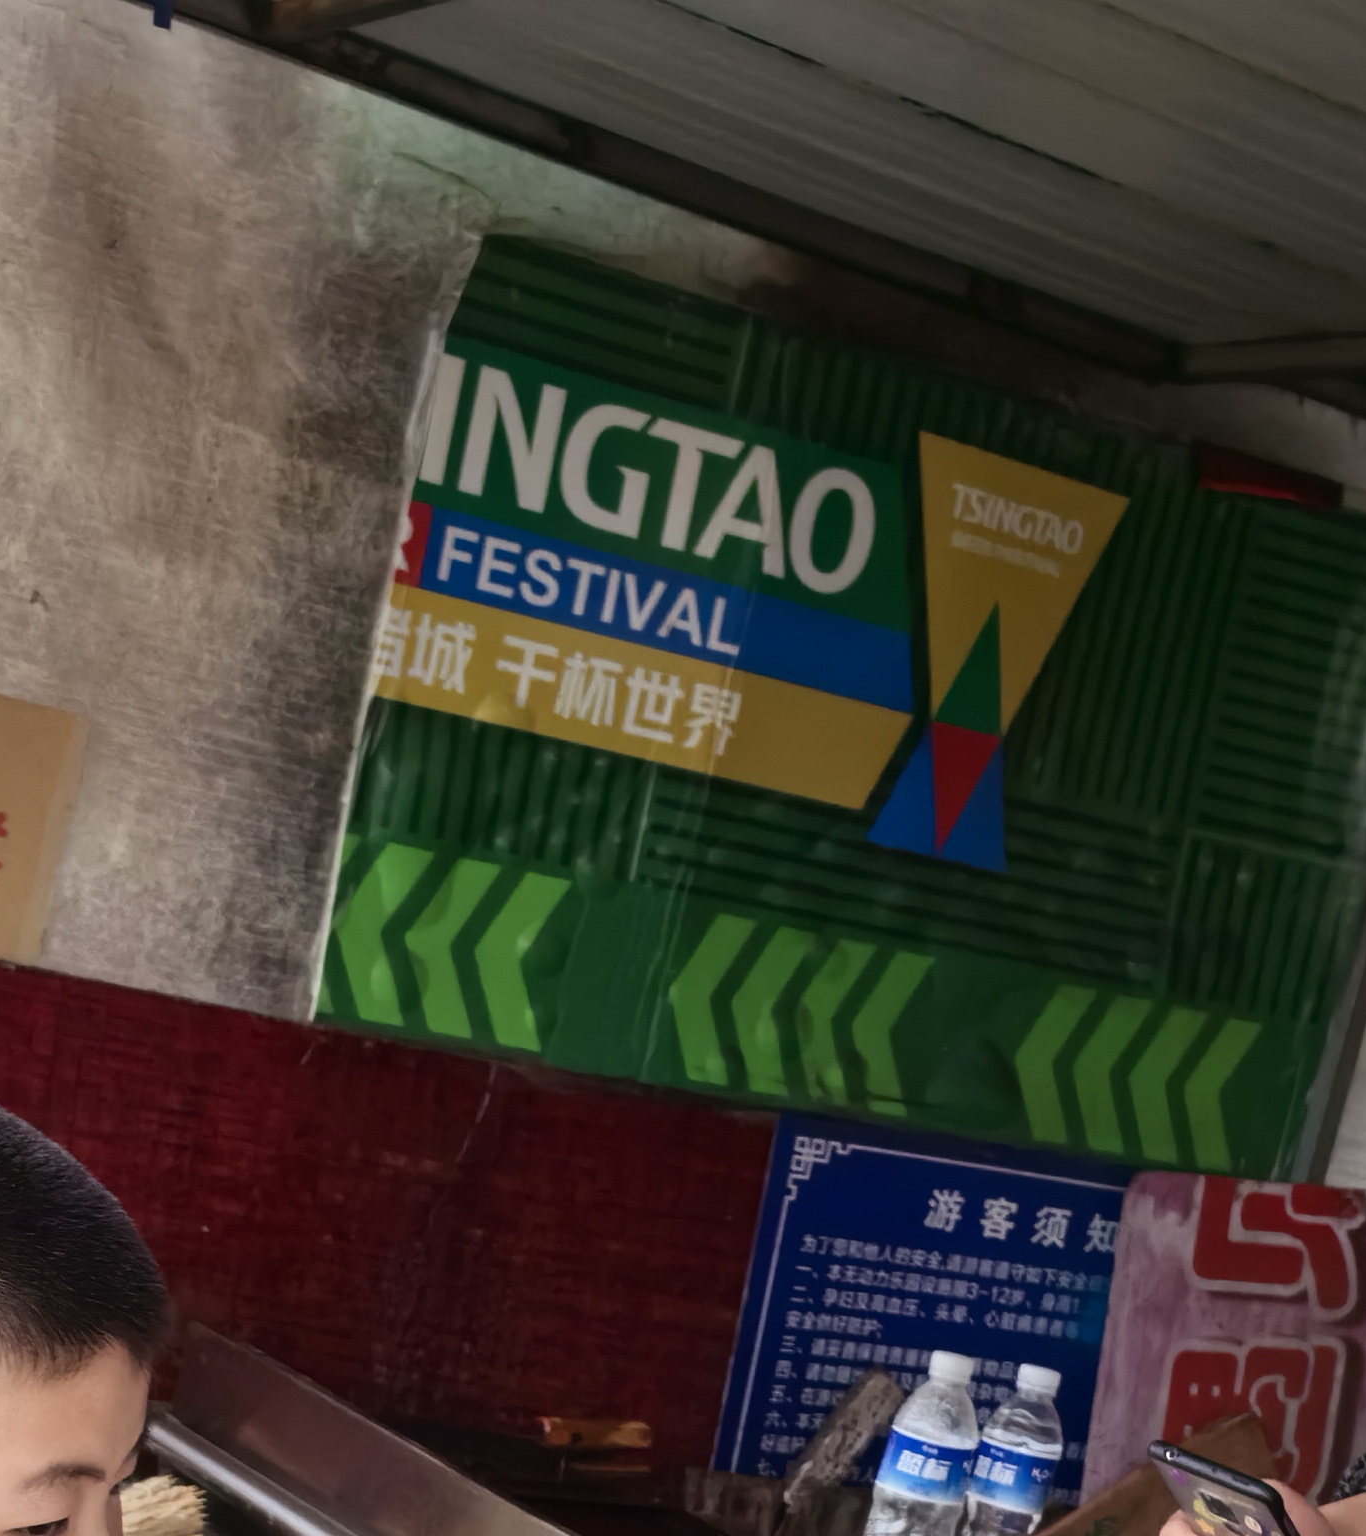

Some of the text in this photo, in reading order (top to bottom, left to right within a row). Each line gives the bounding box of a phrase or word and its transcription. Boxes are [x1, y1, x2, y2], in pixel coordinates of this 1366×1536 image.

[418, 352, 876, 595] INGTAO
[951, 481, 1084, 555] TSINGTAO
[436, 524, 741, 657] FESTIVAL
[495, 634, 743, 756] 干杯世界
[923, 1188, 1121, 1255] 游客须知
